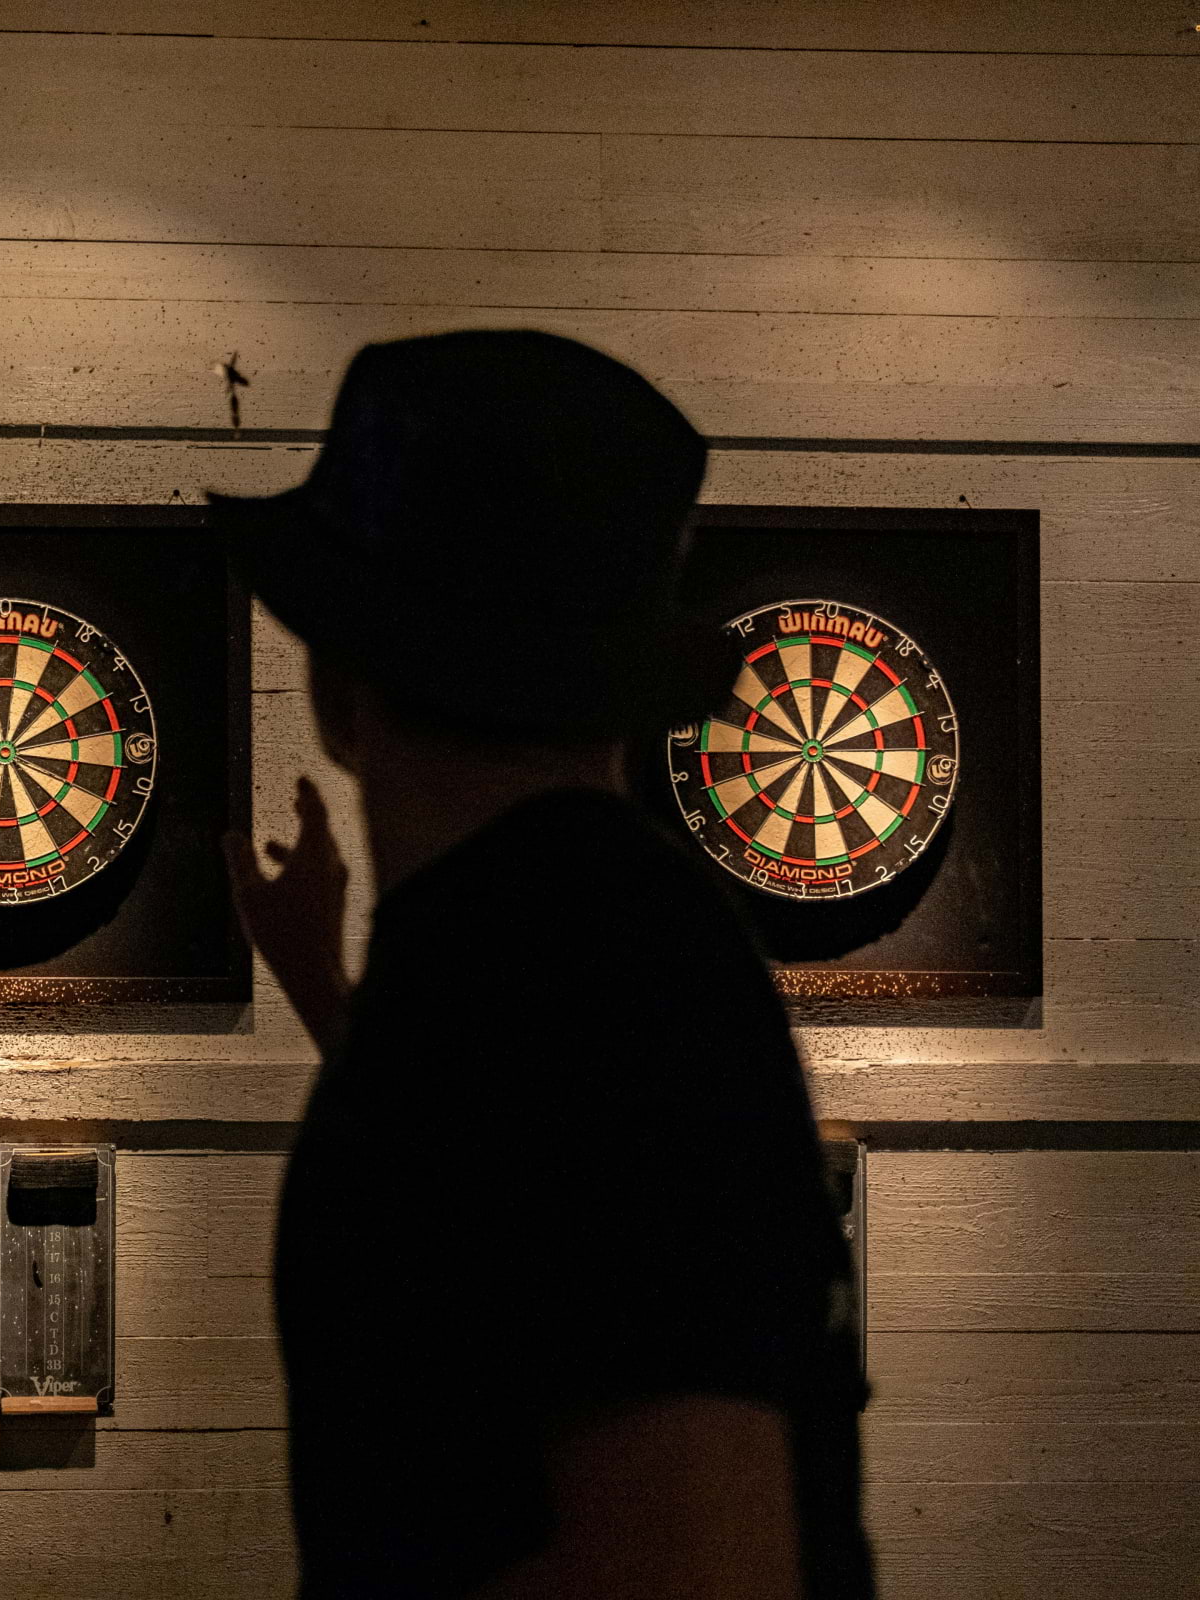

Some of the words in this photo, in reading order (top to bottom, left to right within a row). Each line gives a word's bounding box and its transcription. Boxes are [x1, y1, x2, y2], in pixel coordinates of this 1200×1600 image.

[40, 605, 50, 624] 1
[780, 603, 792, 619] 5
[814, 600, 839, 618] 20
[75, 620, 95, 643] 18
[732, 617, 755, 638] 12
[865, 613, 874, 632] 1
[895, 636, 915, 657] 18
[112, 656, 127, 672] 4
[926, 674, 941, 689] 4
[129, 688, 151, 713] 13
[937, 713, 958, 733] 13
[672, 771, 689, 783] 8
[132, 777, 153, 799] 10
[928, 795, 949, 818] 10
[684, 809, 706, 832] 16
[112, 819, 134, 844] 15
[717, 844, 730, 861] 7
[904, 835, 926, 860] 15
[87, 856, 108, 873] 2
[743, 849, 853, 880] DIAMOND
[875, 866, 895, 881] 2
[47, 875, 68, 897] 17
[743, 867, 769, 887] 19
[7, 887, 19, 904] 3
[794, 882, 806, 898] 3
[834, 879, 853, 897] 17
[49, 1231, 61, 1242] 18
[49, 1252, 61, 1263] 17
[49, 1273, 61, 1283] 16
[49, 1294, 61, 1305] 15
[50, 1311, 59, 1322] C
[50, 1328, 59, 1338] T
[50, 1344, 59, 1355] D
[46, 1359, 62, 1370] 3B
[30, 1375, 78, 1396] Viper
